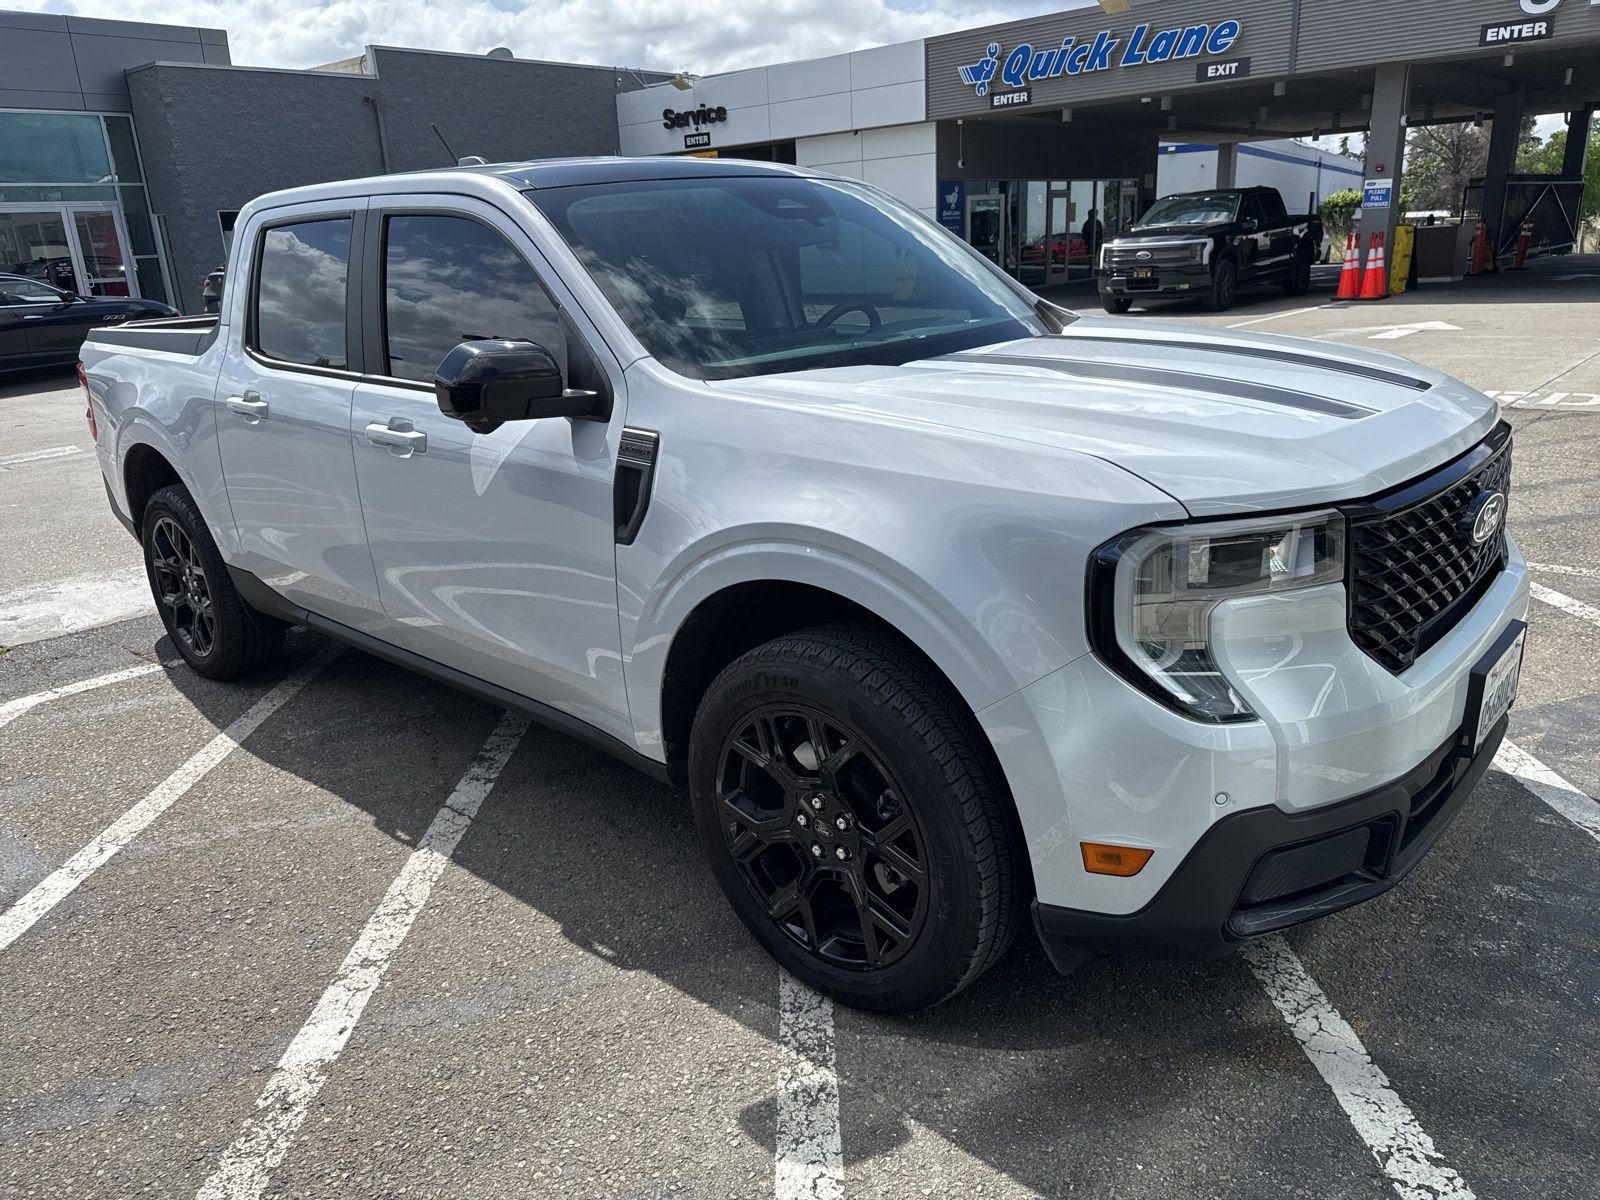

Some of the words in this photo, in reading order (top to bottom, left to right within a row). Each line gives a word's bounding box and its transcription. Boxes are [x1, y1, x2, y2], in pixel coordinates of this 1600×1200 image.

[1486, 22, 1548, 42] ENTER
[1001, 31, 1119, 88] Quick
[1119, 20, 1240, 68] Lane
[1207, 62, 1239, 77] EXIT
[993, 91, 1028, 106] ENTER
[663, 103, 727, 129] Service
[686, 135, 709, 146] ENTER
